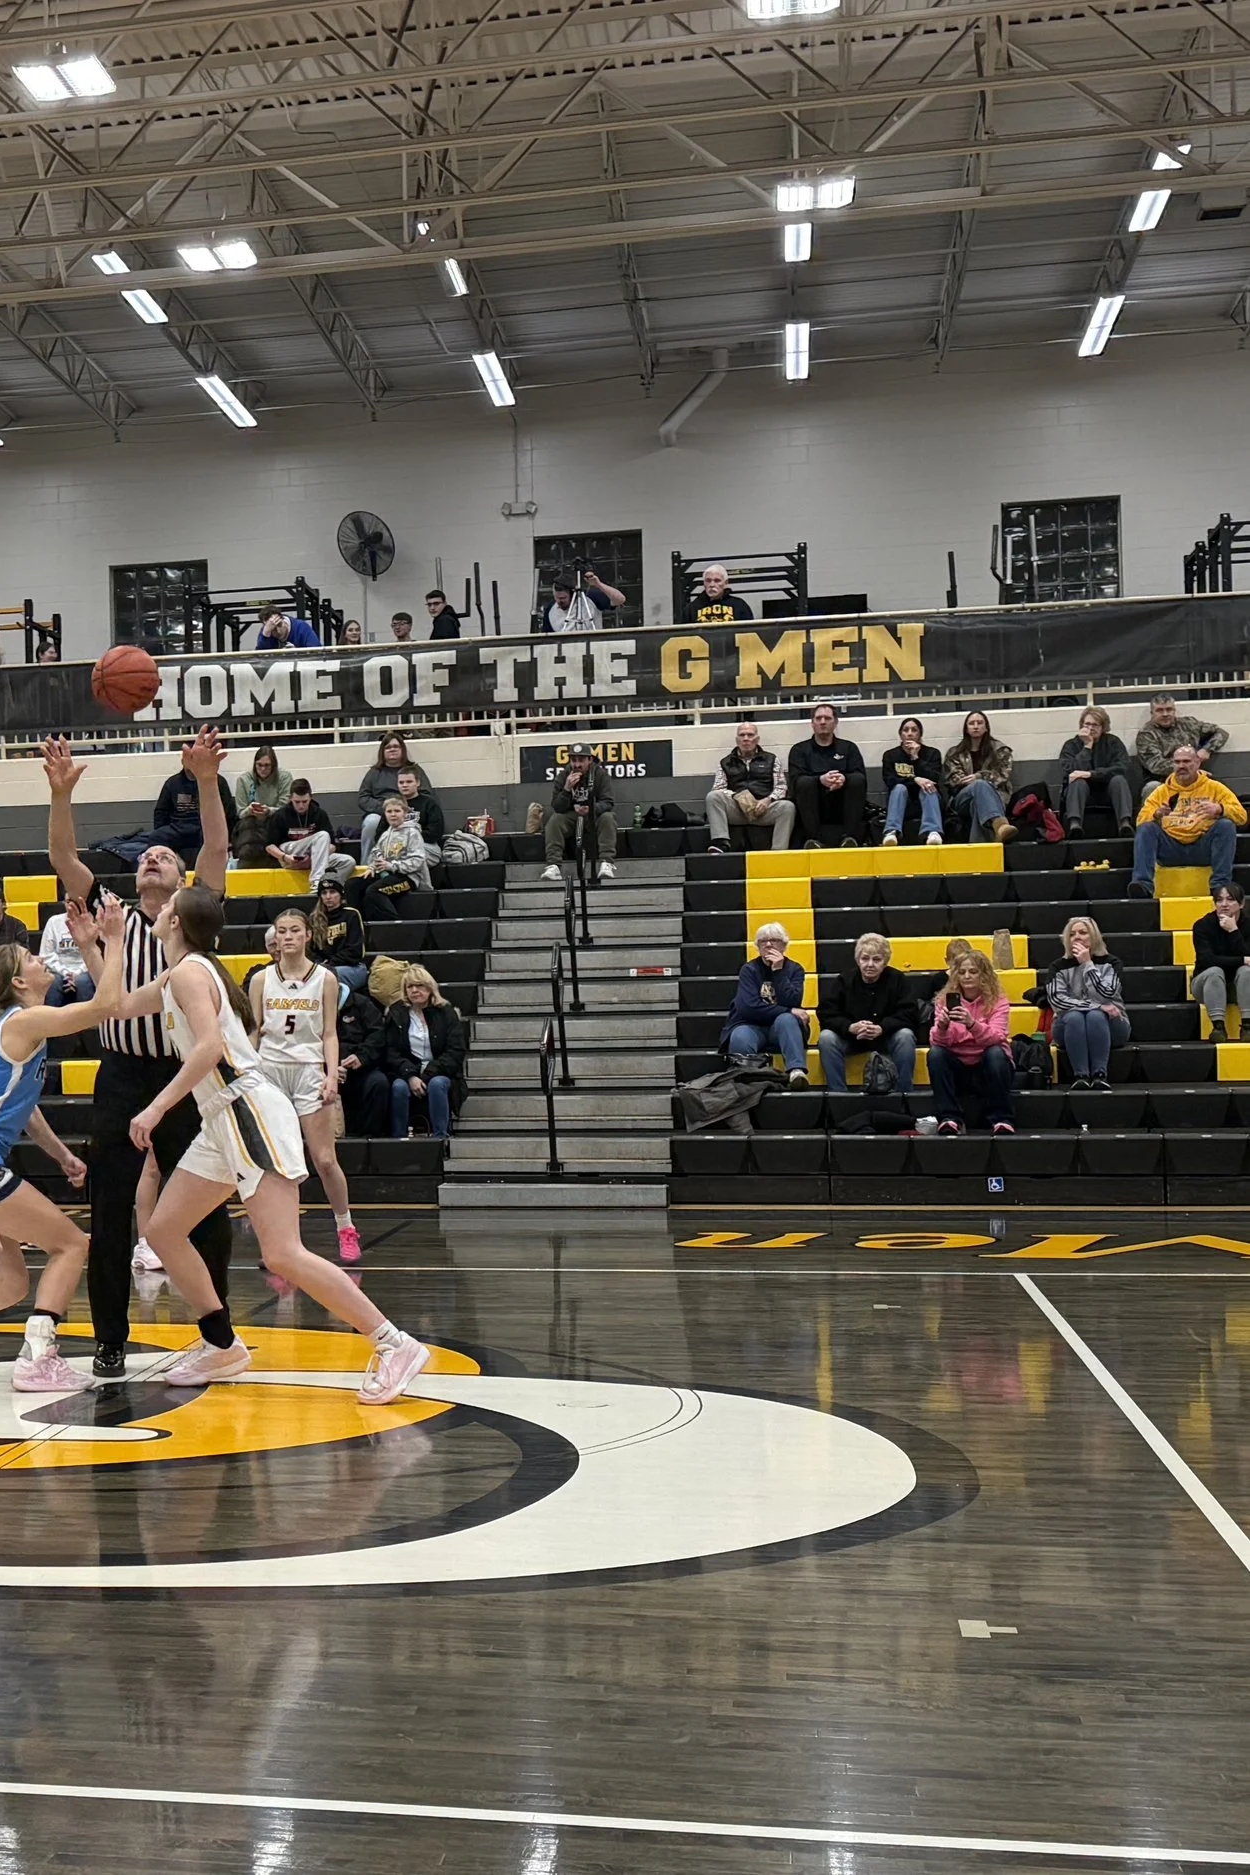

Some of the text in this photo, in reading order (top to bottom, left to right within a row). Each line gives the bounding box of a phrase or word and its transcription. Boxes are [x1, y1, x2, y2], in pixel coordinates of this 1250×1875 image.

[363, 650, 457, 709] OF
[479, 639, 637, 702] THE
[661, 635, 710, 693] G
[735, 622, 926, 690] MEN
[556, 742, 635, 764] GMEN
[284, 1014, 296, 1035] 5
